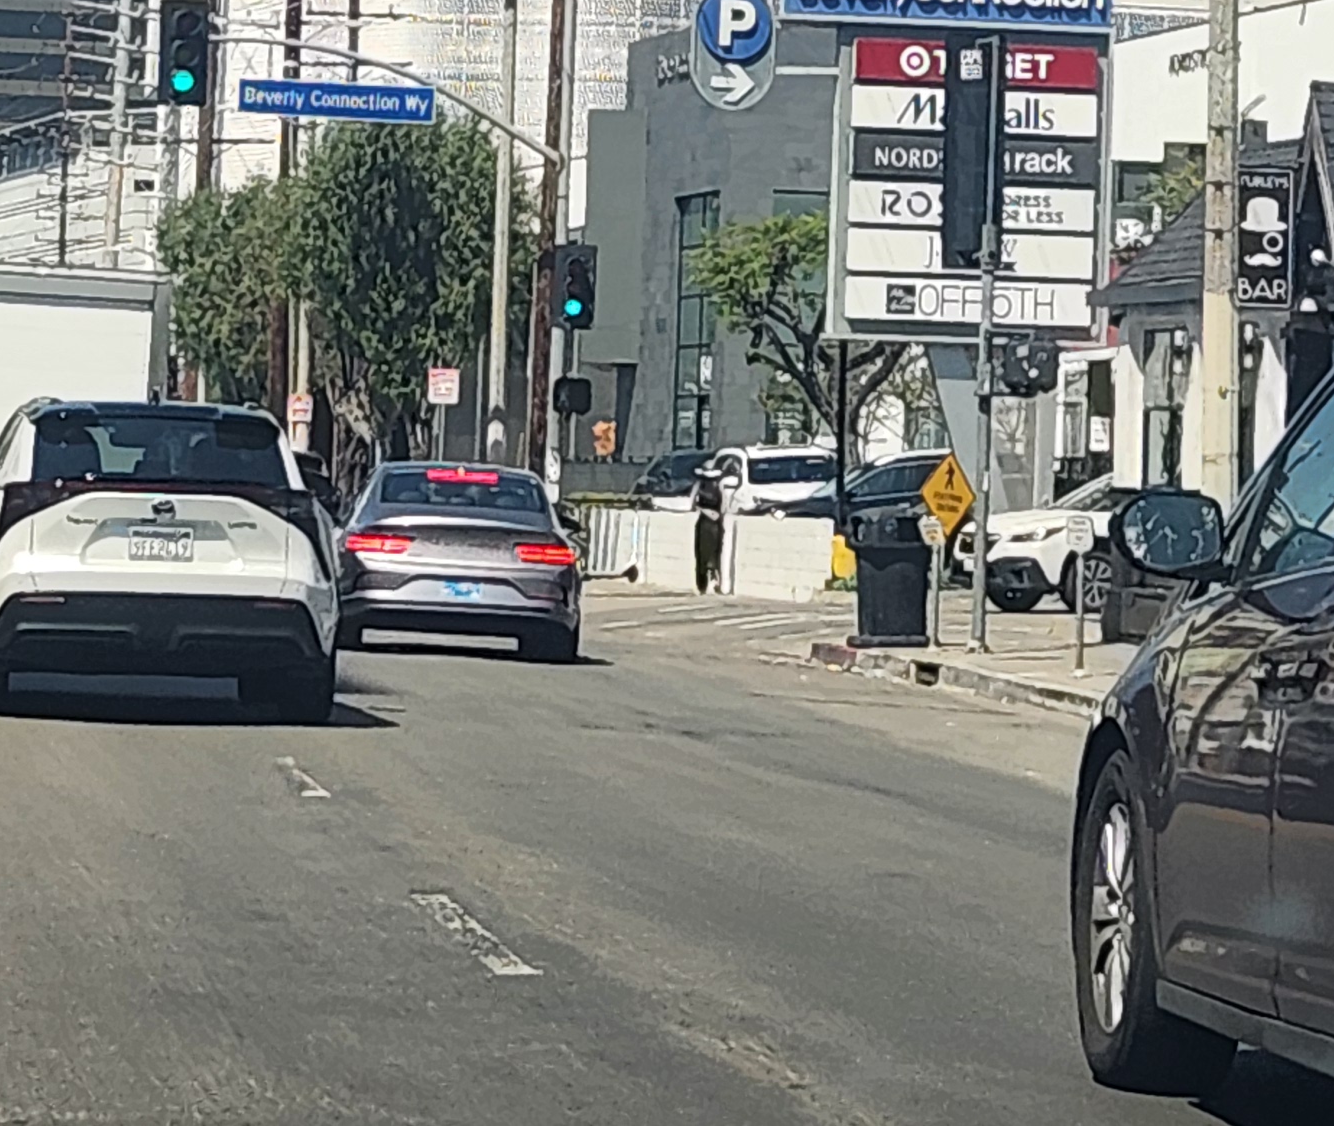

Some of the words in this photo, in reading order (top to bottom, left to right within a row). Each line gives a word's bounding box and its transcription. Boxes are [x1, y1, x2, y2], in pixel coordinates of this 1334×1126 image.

[718, 0, 756, 47] P
[243, 85, 305, 112] Beverly
[310, 89, 400, 112] Connection
[404, 93, 430, 117] Wy
[1015, 147, 1073, 175] rack
[1237, 277, 1287, 300] BAR
